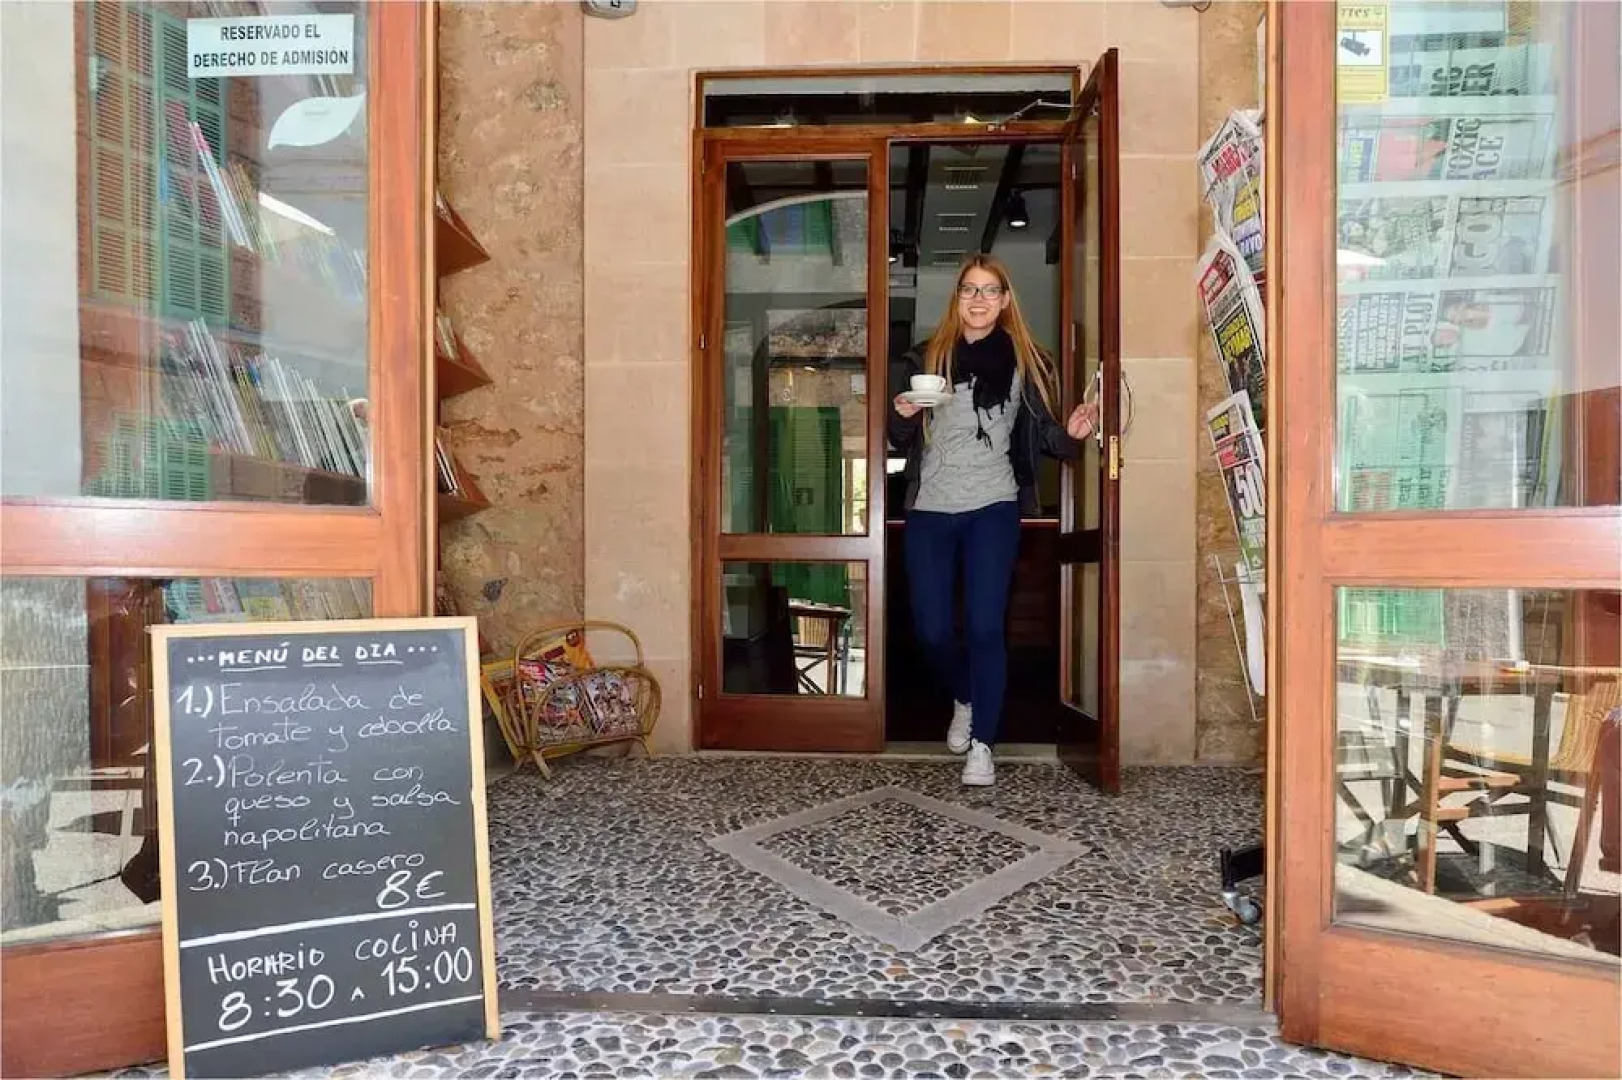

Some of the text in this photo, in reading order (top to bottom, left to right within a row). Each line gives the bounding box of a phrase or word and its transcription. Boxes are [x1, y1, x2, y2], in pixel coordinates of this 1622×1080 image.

[220, 23, 321, 41] RESERVADO EL
[193, 46, 348, 67] DERECHO DE ADMISIÓN
[302, 646, 340, 662] DEL
[220, 682, 370, 715] Ensalada
[388, 684, 423, 710] de
[208, 716, 312, 750] tomate
[328, 724, 350, 752] y
[227, 754, 349, 789] Polenta
[372, 764, 425, 783] con
[223, 783, 462, 828] queso y salsa
[223, 815, 391, 851] napolitana
[229, 857, 301, 885] Flan
[322, 852, 426, 881] casero
[217, 974, 336, 1032] 8:30
[380, 946, 474, 996] 15:00
